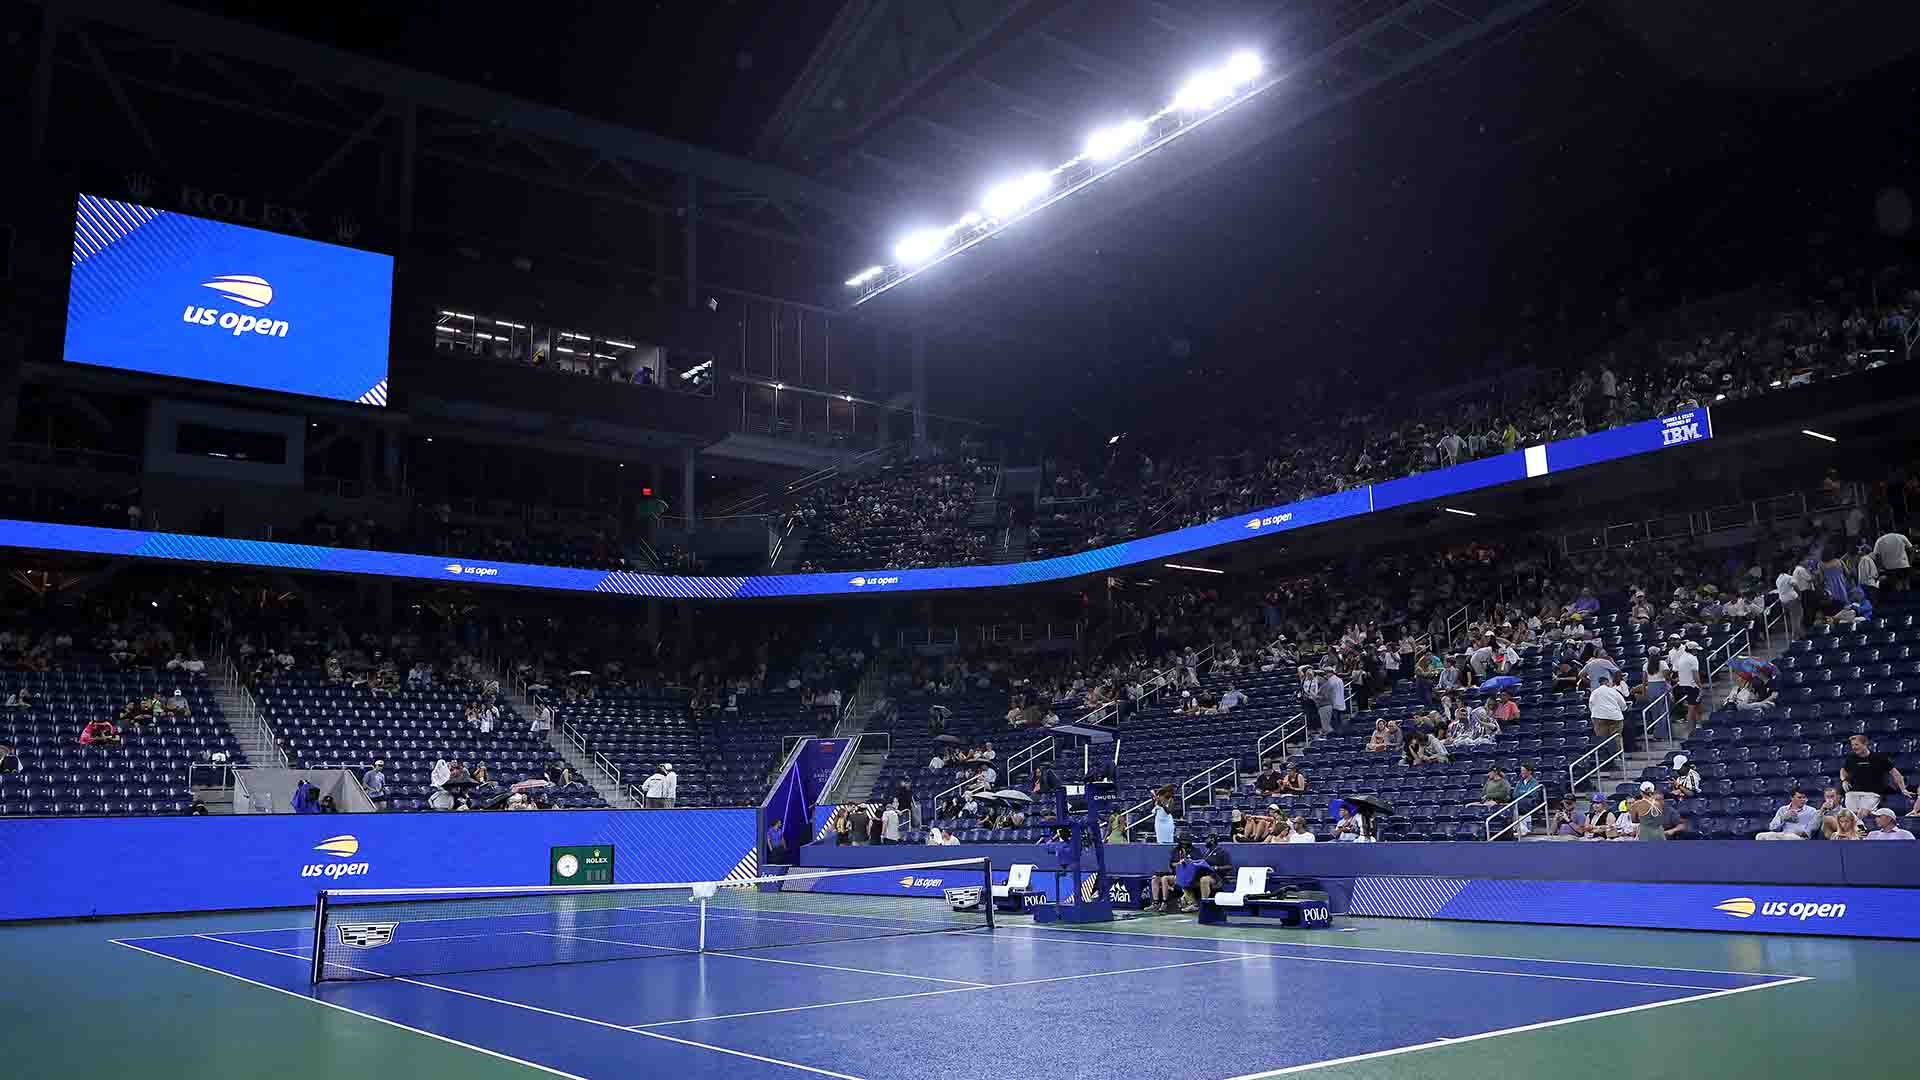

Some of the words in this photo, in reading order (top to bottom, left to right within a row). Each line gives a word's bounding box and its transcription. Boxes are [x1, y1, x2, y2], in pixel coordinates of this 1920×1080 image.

[179, 184, 310, 234] ROLEX
[183, 305, 219, 326] us
[219, 312, 289, 337] open
[1662, 423, 1703, 446] IBM
[1272, 512, 1293, 526] open
[475, 568, 498, 577] open
[877, 576, 898, 586] open
[301, 864, 323, 877] us
[323, 862, 369, 880] open
[923, 878, 943, 889] open
[1024, 894, 1047, 906] POLO
[1303, 906, 1329, 922] POLO
[1761, 902, 1788, 916] us
[1788, 902, 1847, 921] open
